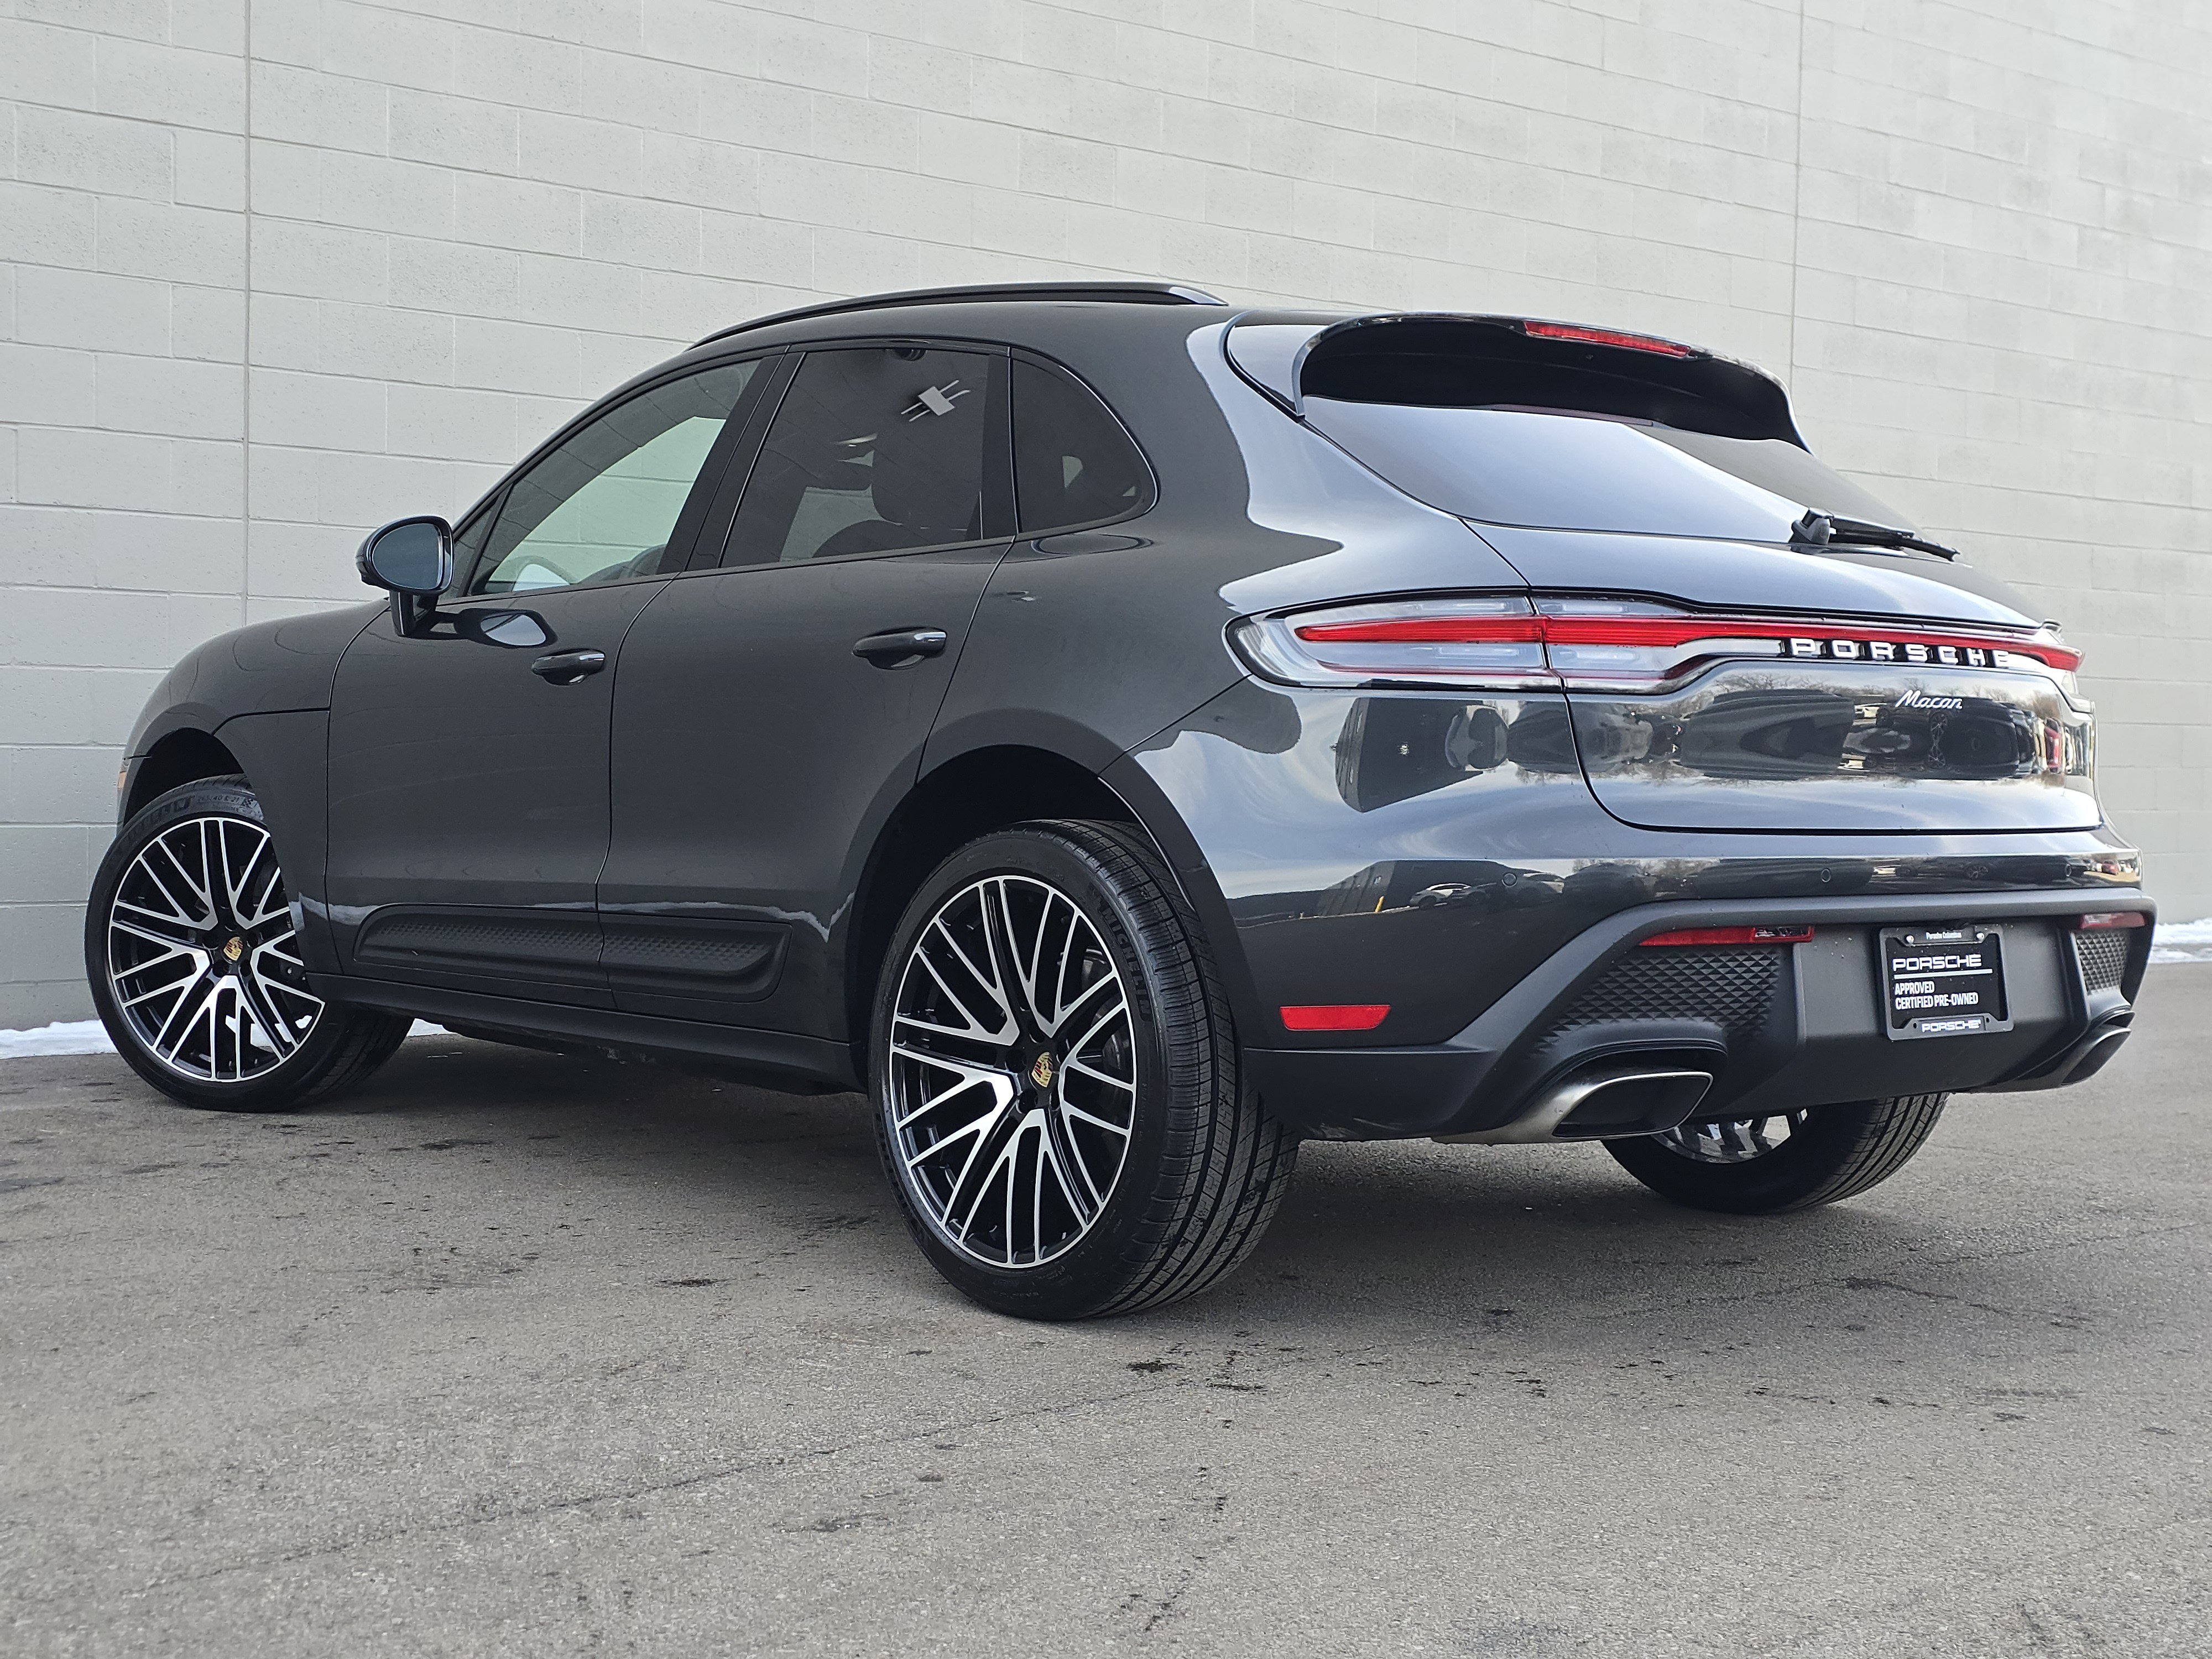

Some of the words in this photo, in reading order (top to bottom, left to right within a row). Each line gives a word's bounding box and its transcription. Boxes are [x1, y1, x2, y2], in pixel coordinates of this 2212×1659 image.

[1790, 638, 2009, 667] PORSCHE
[1895, 690, 1963, 709] Macan
[1104, 907, 1151, 1014] MICHELIN
[1893, 954, 1981, 971] PORSCHE
[1895, 981, 1935, 995] APPROVED
[1895, 995, 1934, 1010] CERTIFIED
[1934, 992, 1979, 1007] PRE-OWNED
[1922, 1019, 1981, 1032] PORSCHE
